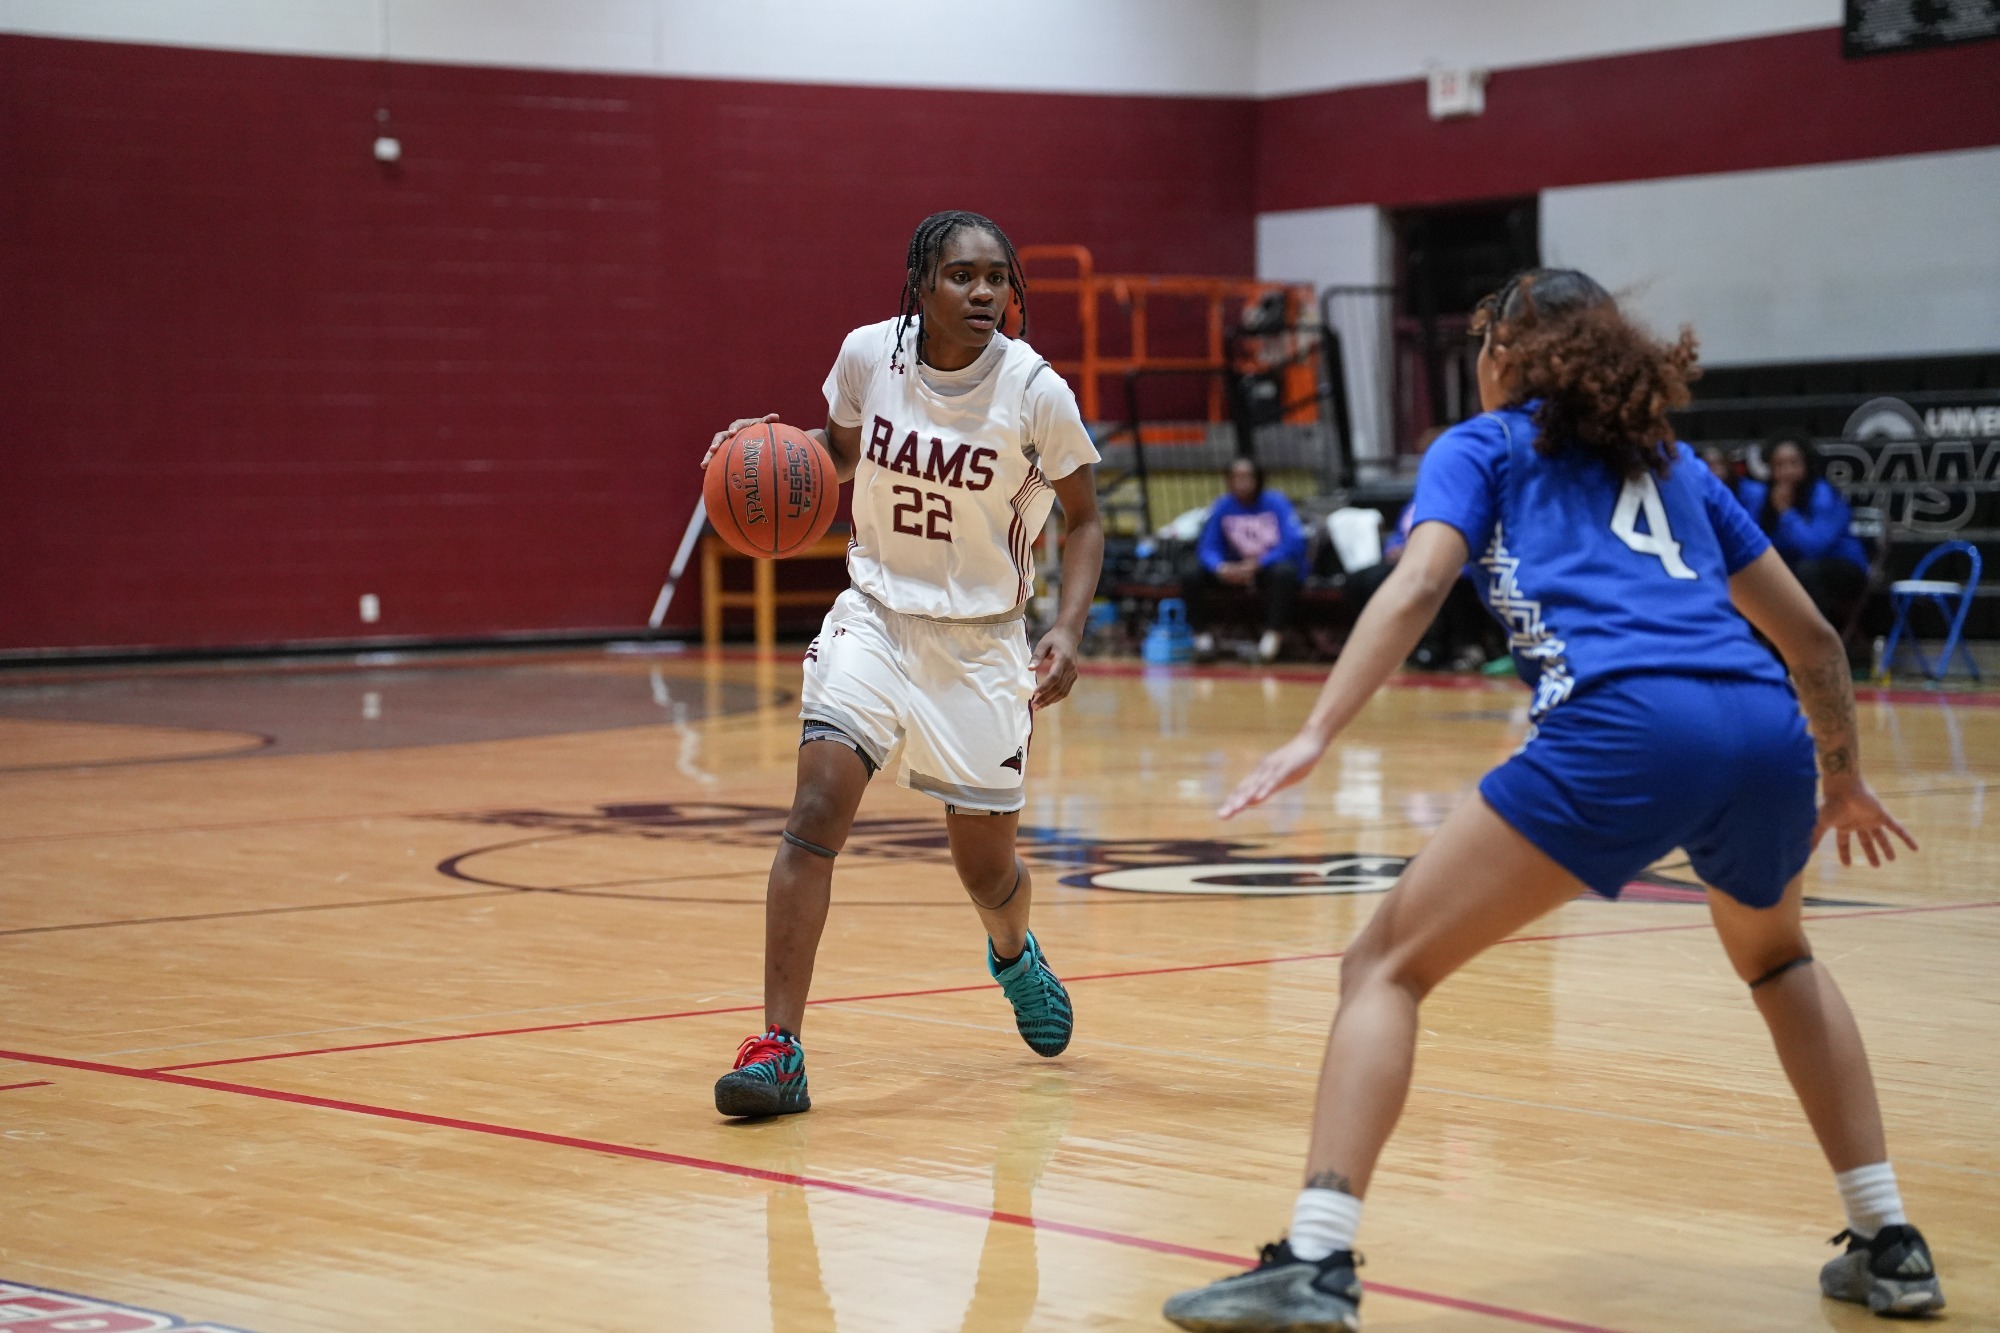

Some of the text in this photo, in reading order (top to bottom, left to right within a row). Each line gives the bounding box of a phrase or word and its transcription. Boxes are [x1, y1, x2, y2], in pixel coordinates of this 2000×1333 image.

[742, 438, 769, 525] SPALDING
[782, 440, 804, 519] LEGACY
[866, 414, 998, 491] RAMS
[892, 484, 954, 544] 22
[1609, 470, 1698, 580] 4
